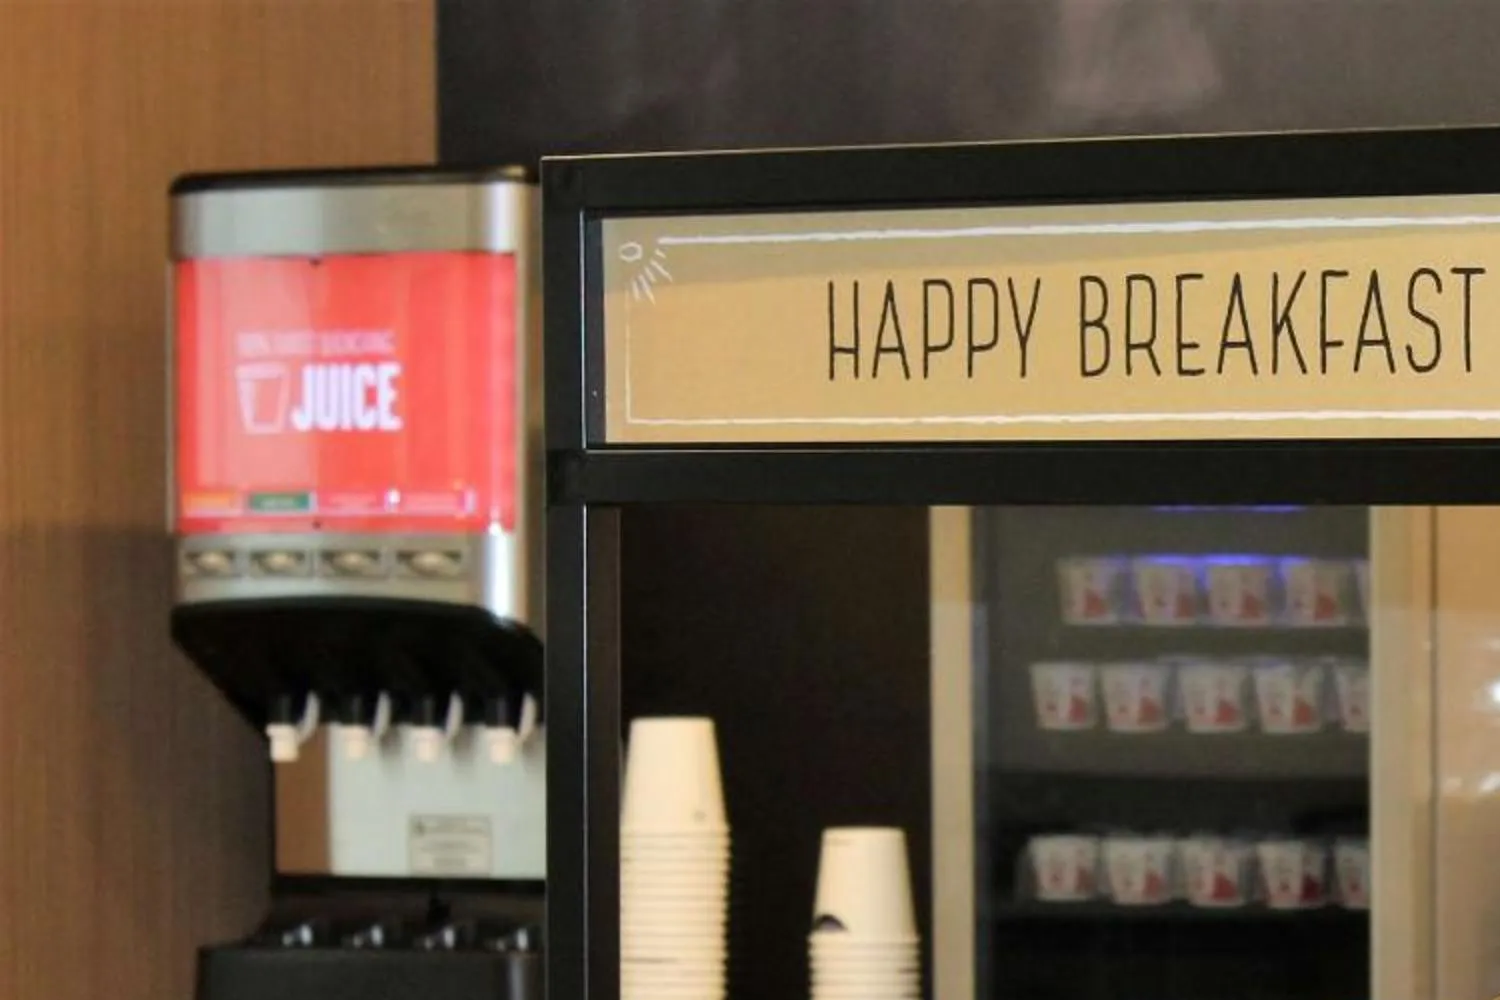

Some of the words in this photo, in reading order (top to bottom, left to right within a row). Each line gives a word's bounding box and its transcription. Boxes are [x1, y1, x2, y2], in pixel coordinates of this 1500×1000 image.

[828, 277, 1041, 381] HAPPY
[1079, 267, 1486, 378] BREAKFAST
[291, 363, 403, 432] JUICE
